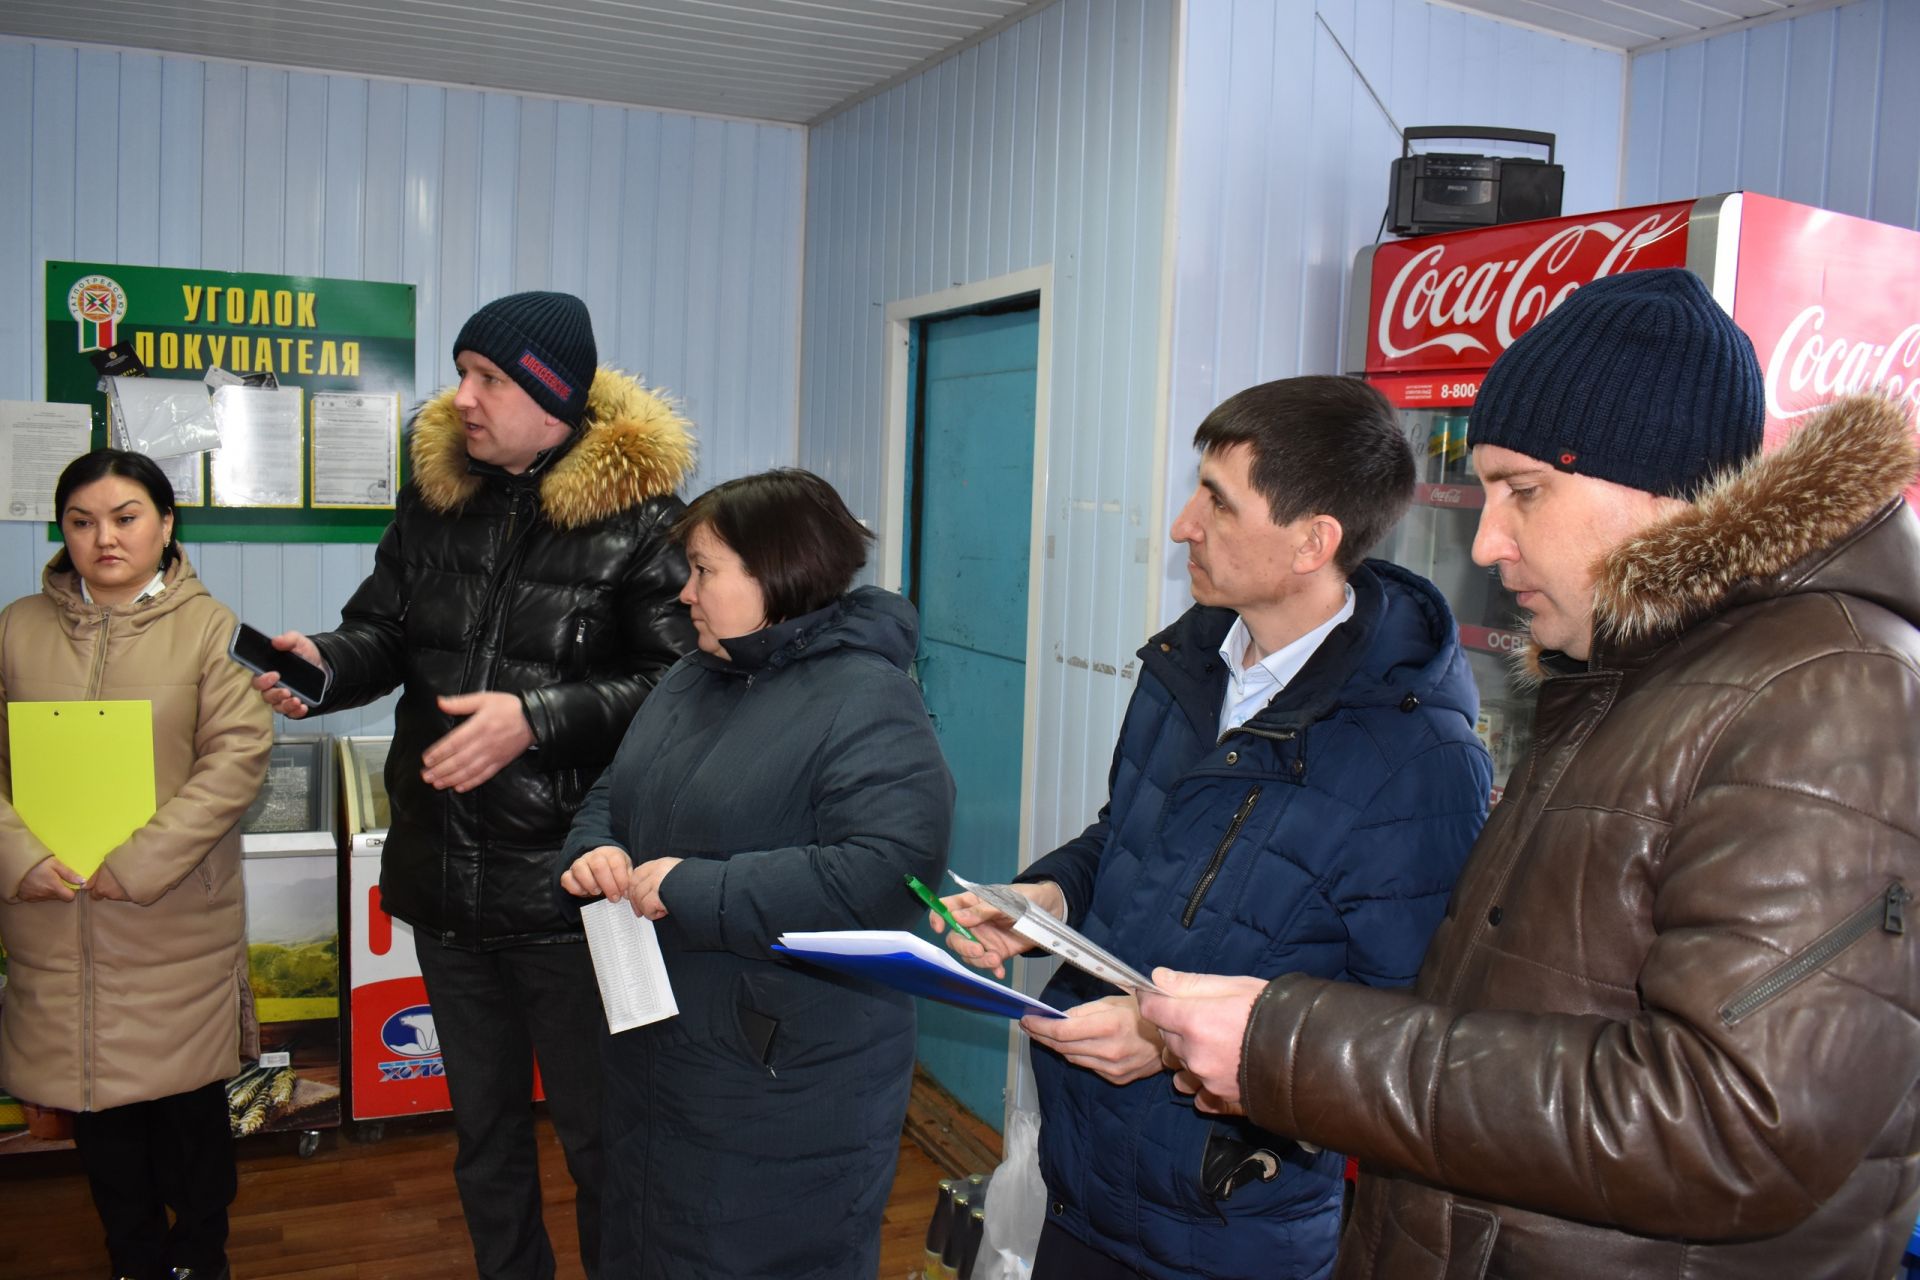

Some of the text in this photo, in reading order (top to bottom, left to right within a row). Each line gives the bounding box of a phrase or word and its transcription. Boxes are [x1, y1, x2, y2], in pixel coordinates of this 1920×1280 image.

[71, 277, 124, 315] ТАТПОТРЕБСОЮЗ
[1379, 209, 1683, 358] Coca-Col
[182, 285, 316, 328] УГОЛОК
[135, 331, 359, 377] ПОКУПАТЕЛЯ
[1440, 383, 1479, 399] 8-800-
[378, 1062, 446, 1083] ХОЛО
